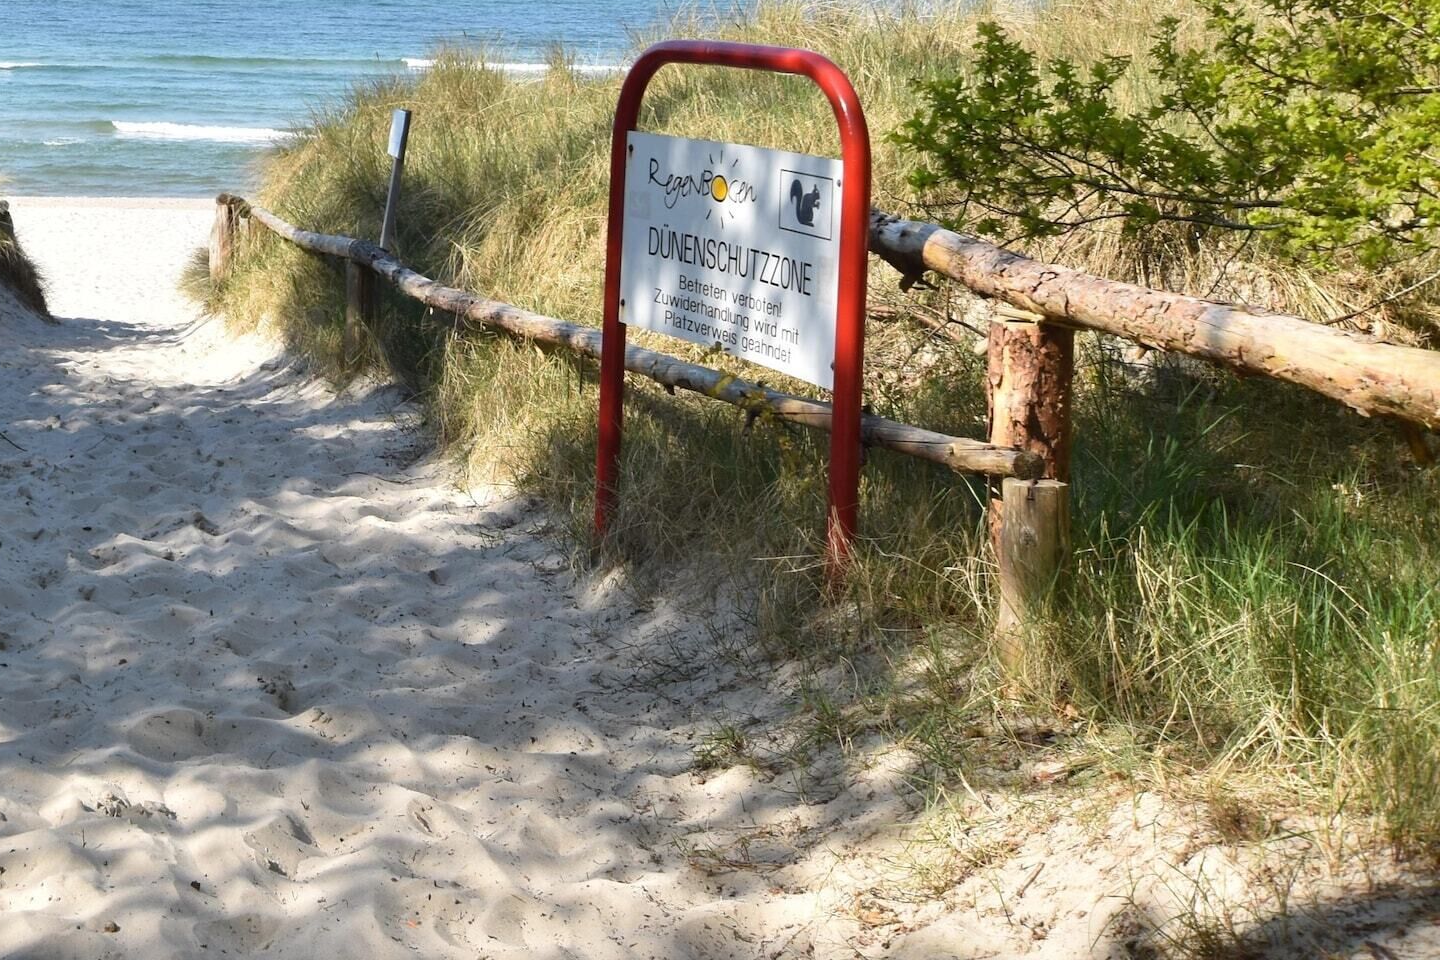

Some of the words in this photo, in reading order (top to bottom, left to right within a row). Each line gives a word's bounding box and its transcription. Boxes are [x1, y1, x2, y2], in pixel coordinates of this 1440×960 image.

[648, 224, 812, 296] DÜNENSCHUTZZONE
[654, 288, 749, 332] Zuwiderhandlung
[754, 318, 777, 338] wird
[782, 328, 799, 345] mit
[679, 275, 727, 300] Betreten
[732, 291, 782, 317] verboten!
[665, 310, 737, 345] Platzverweis
[742, 335, 791, 364] geahndet
